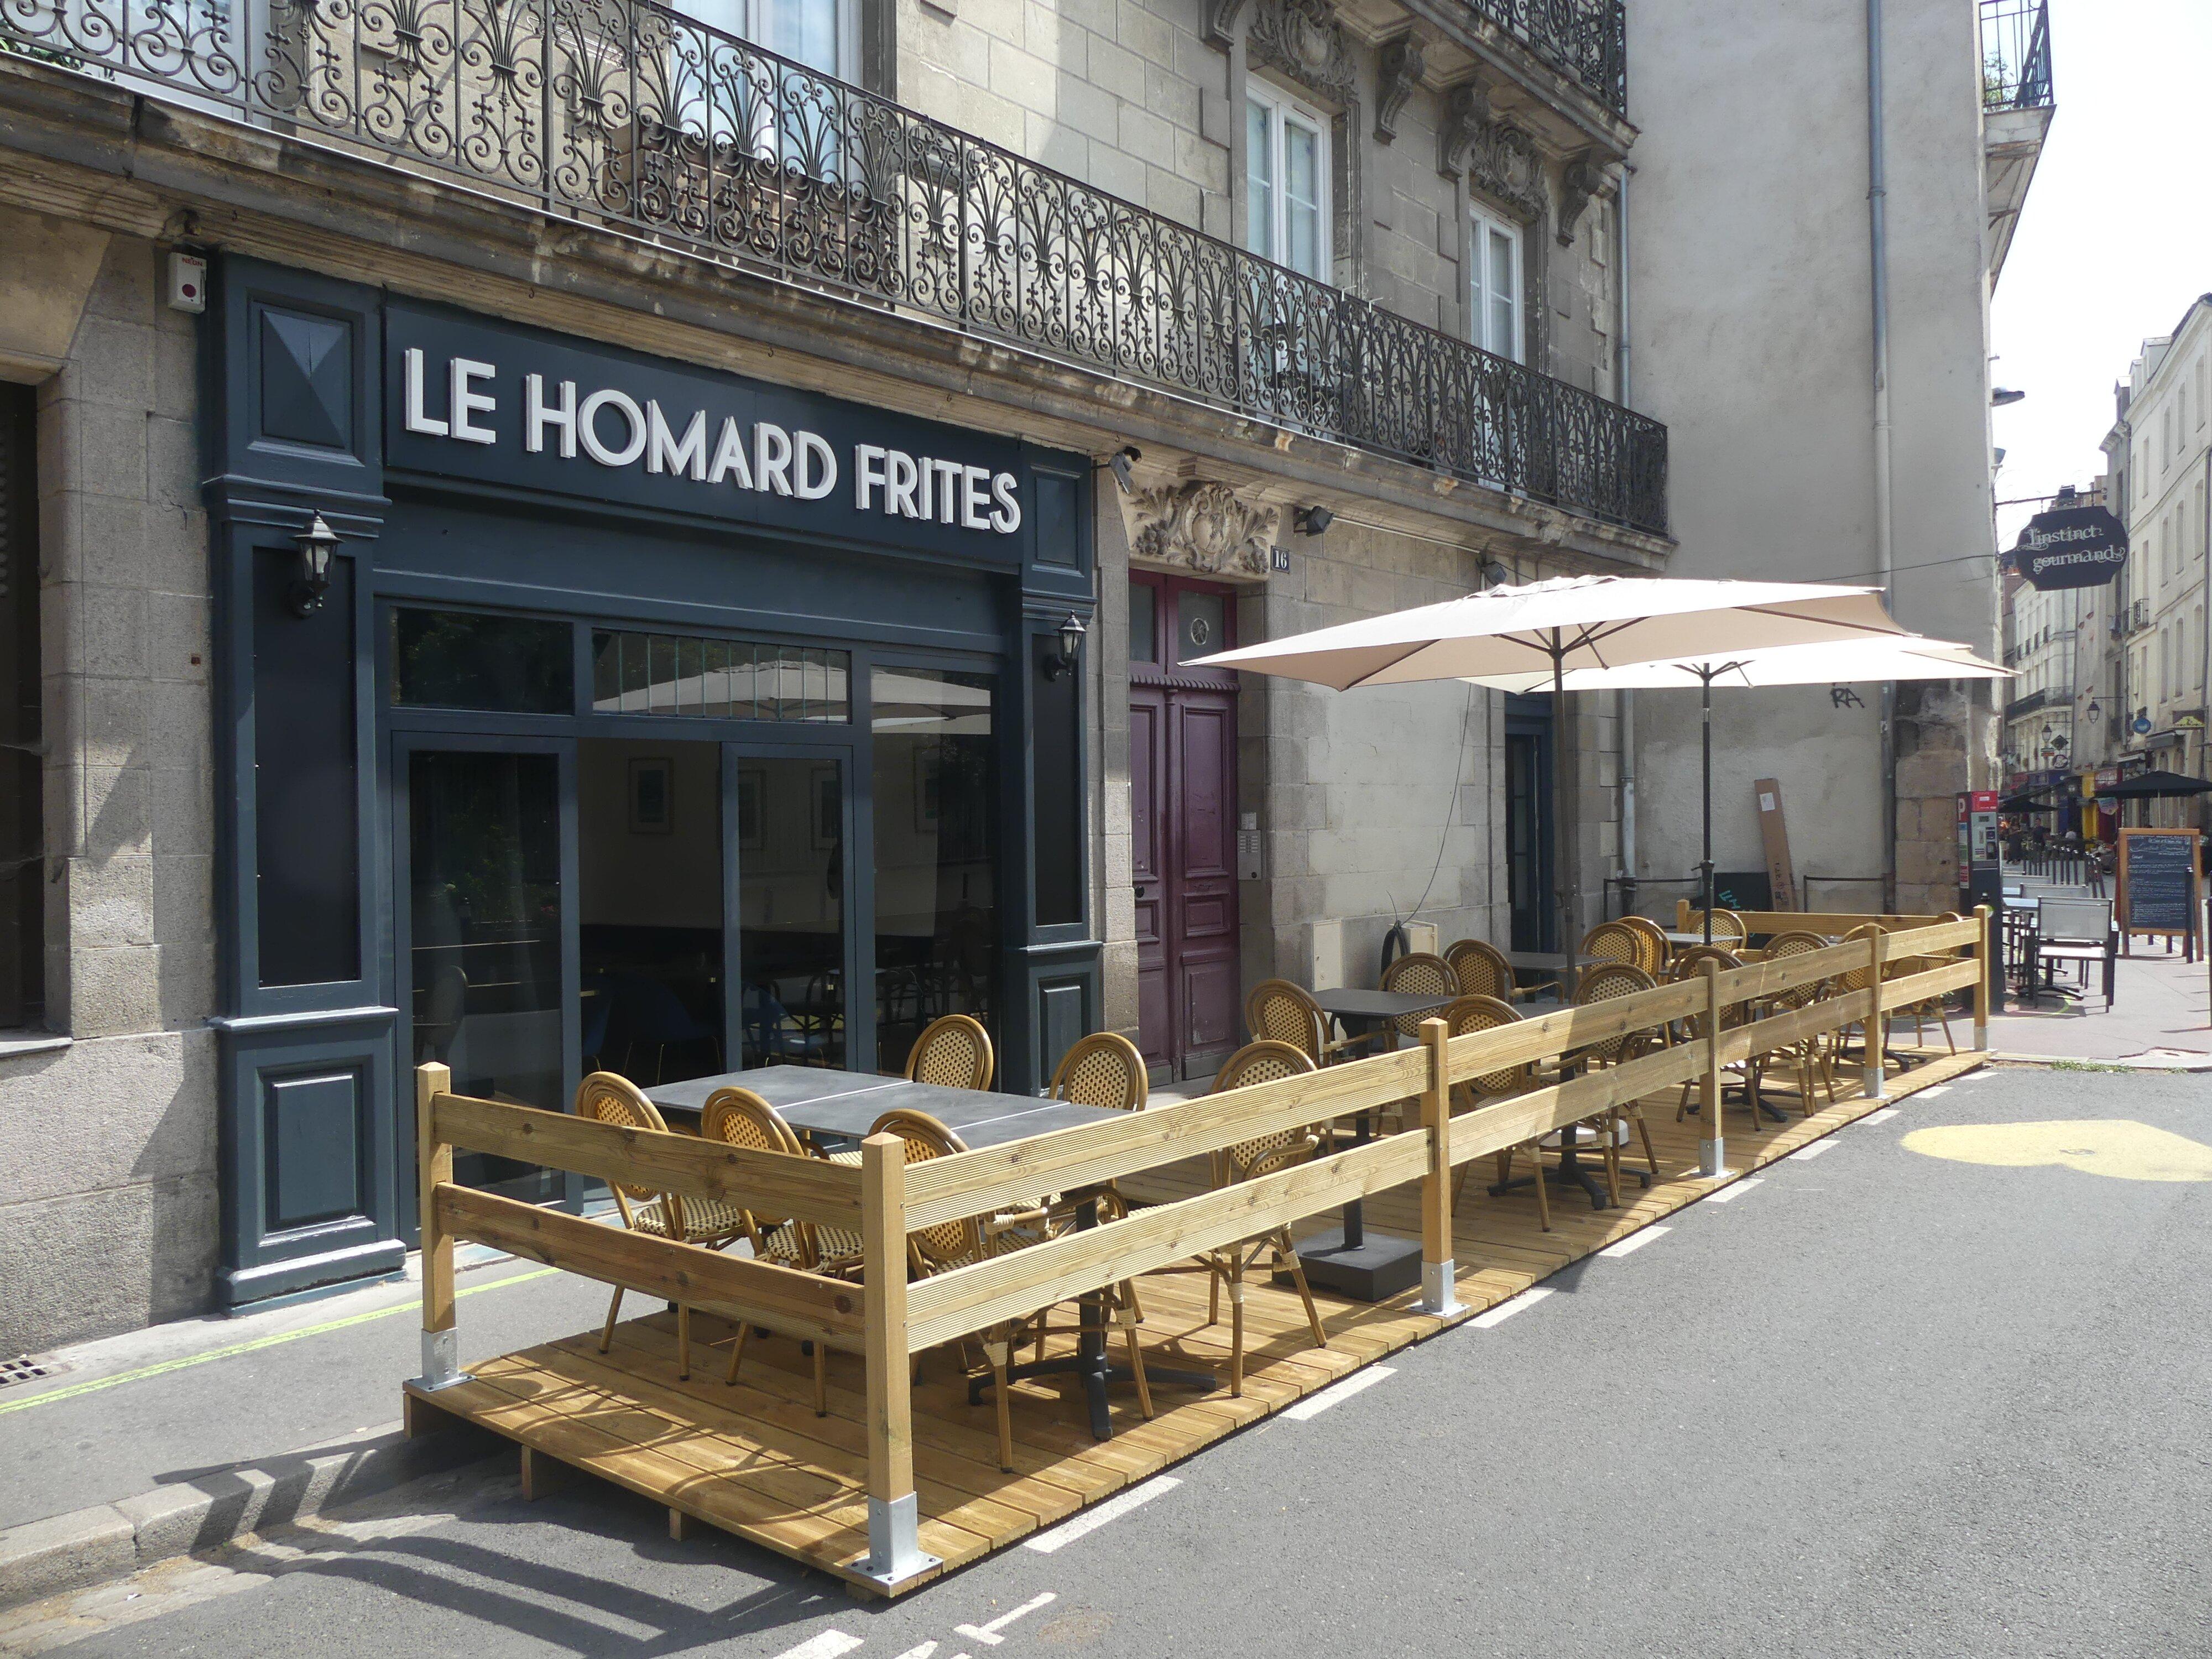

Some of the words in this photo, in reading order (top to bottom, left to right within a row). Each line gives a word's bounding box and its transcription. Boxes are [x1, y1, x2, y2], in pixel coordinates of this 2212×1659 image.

[404, 348, 497, 445] LE
[525, 373, 838, 501] HOMARD
[854, 444, 1021, 535] FRITES
[1275, 550, 1287, 569] 16
[2033, 545, 2126, 575] gourmand
[1958, 798, 1965, 821] P
